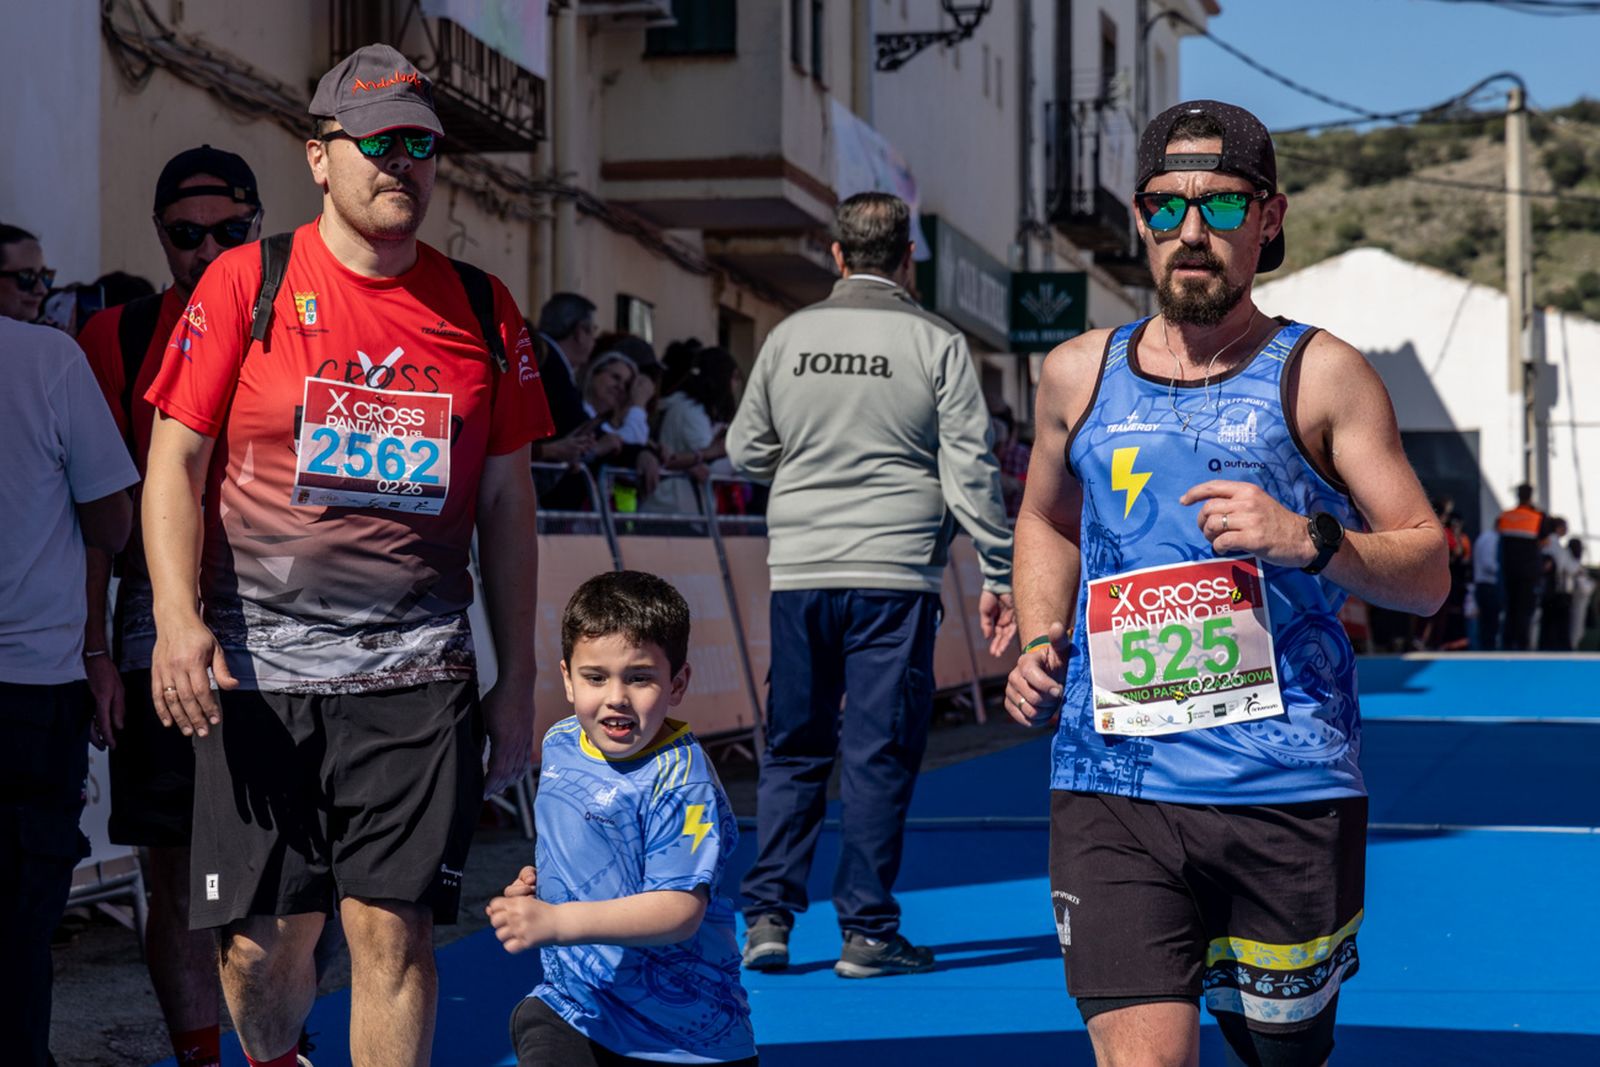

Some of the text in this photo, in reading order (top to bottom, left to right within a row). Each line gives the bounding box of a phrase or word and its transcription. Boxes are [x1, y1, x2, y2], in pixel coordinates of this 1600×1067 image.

[315, 359, 441, 393] CROSS
[327, 388, 350, 416] X
[353, 401, 426, 427] CROSS
[325, 415, 407, 439] PANTANO
[1106, 423, 1160, 433] TEAMERGY
[307, 427, 440, 484] 2562
[1224, 460, 1265, 469] autismo
[1111, 582, 1135, 615] X
[1139, 577, 1230, 611] CROSS
[1111, 604, 1234, 636] PANTANO DEL
[1121, 616, 1240, 687] 525
